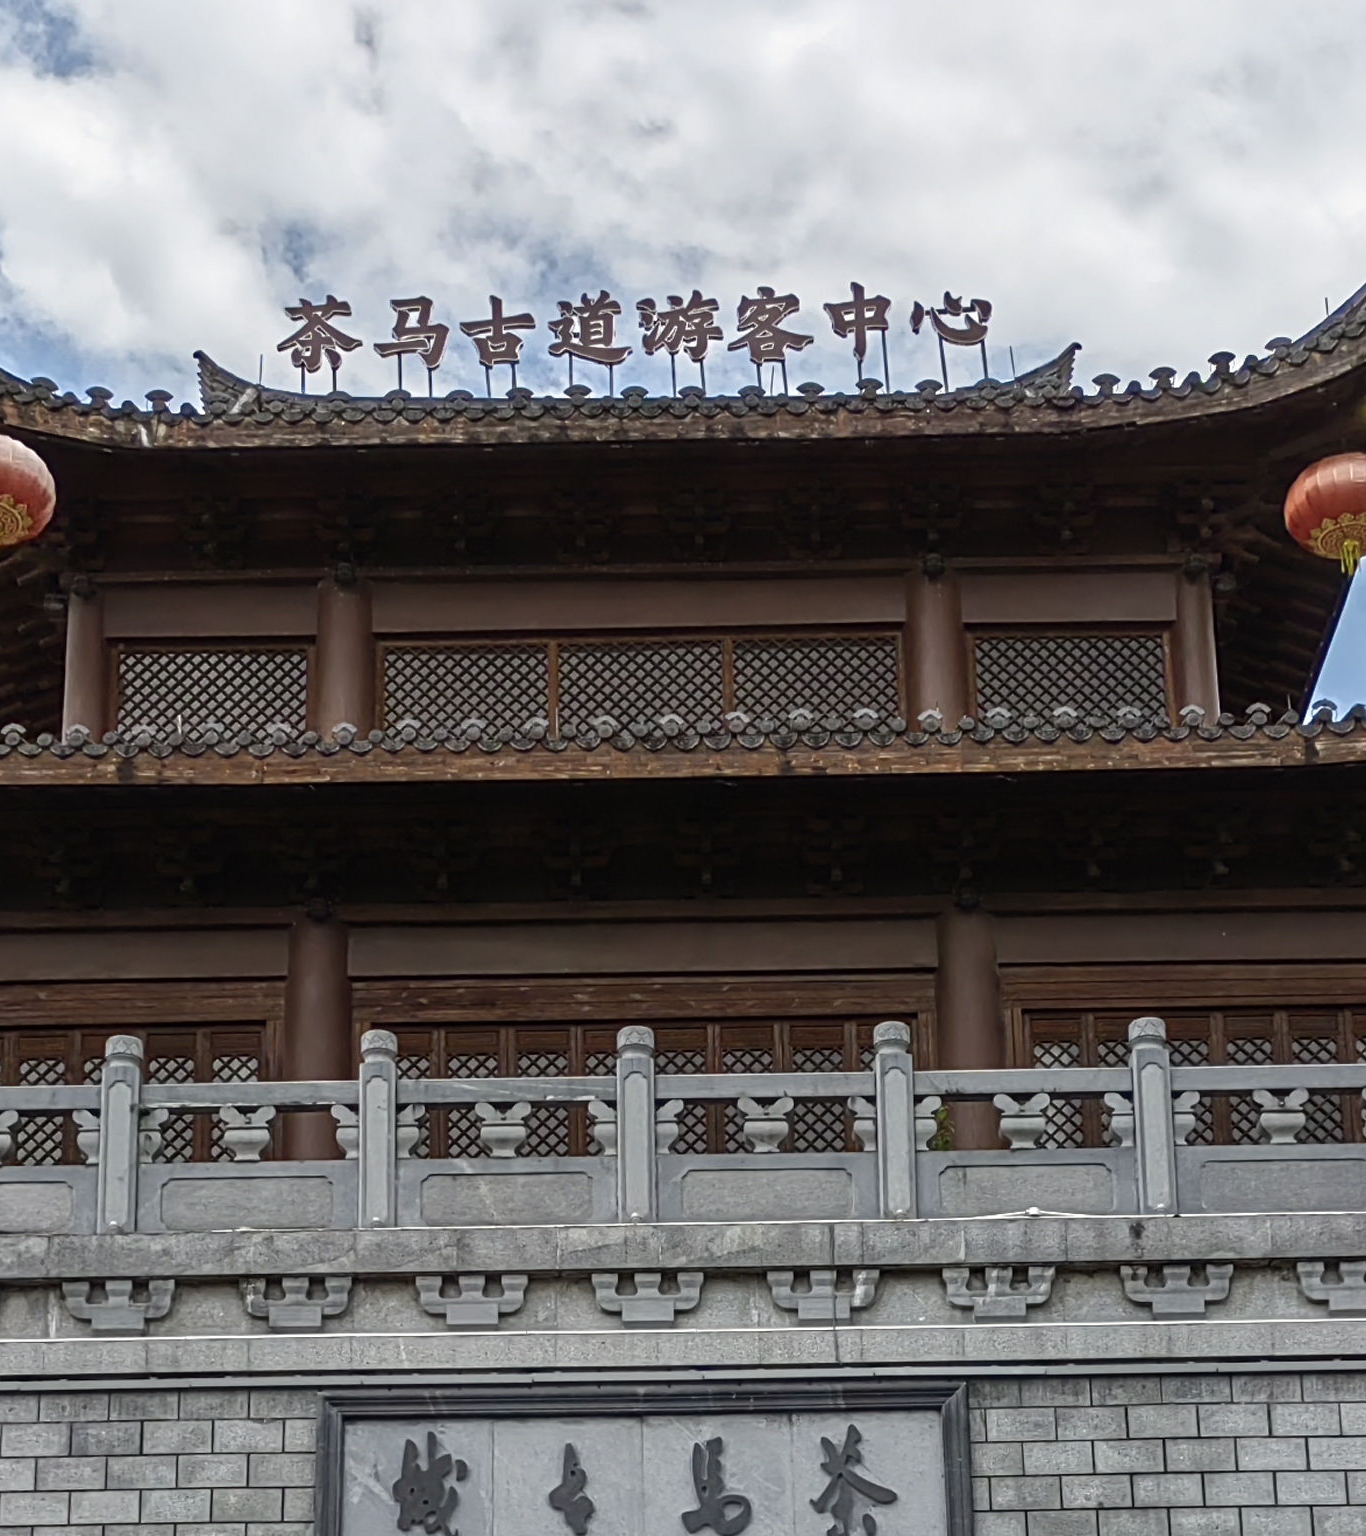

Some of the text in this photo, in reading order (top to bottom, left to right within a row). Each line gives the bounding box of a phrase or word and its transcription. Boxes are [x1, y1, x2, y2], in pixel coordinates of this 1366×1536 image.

[276, 281, 993, 373] 茶马古道游客中心
